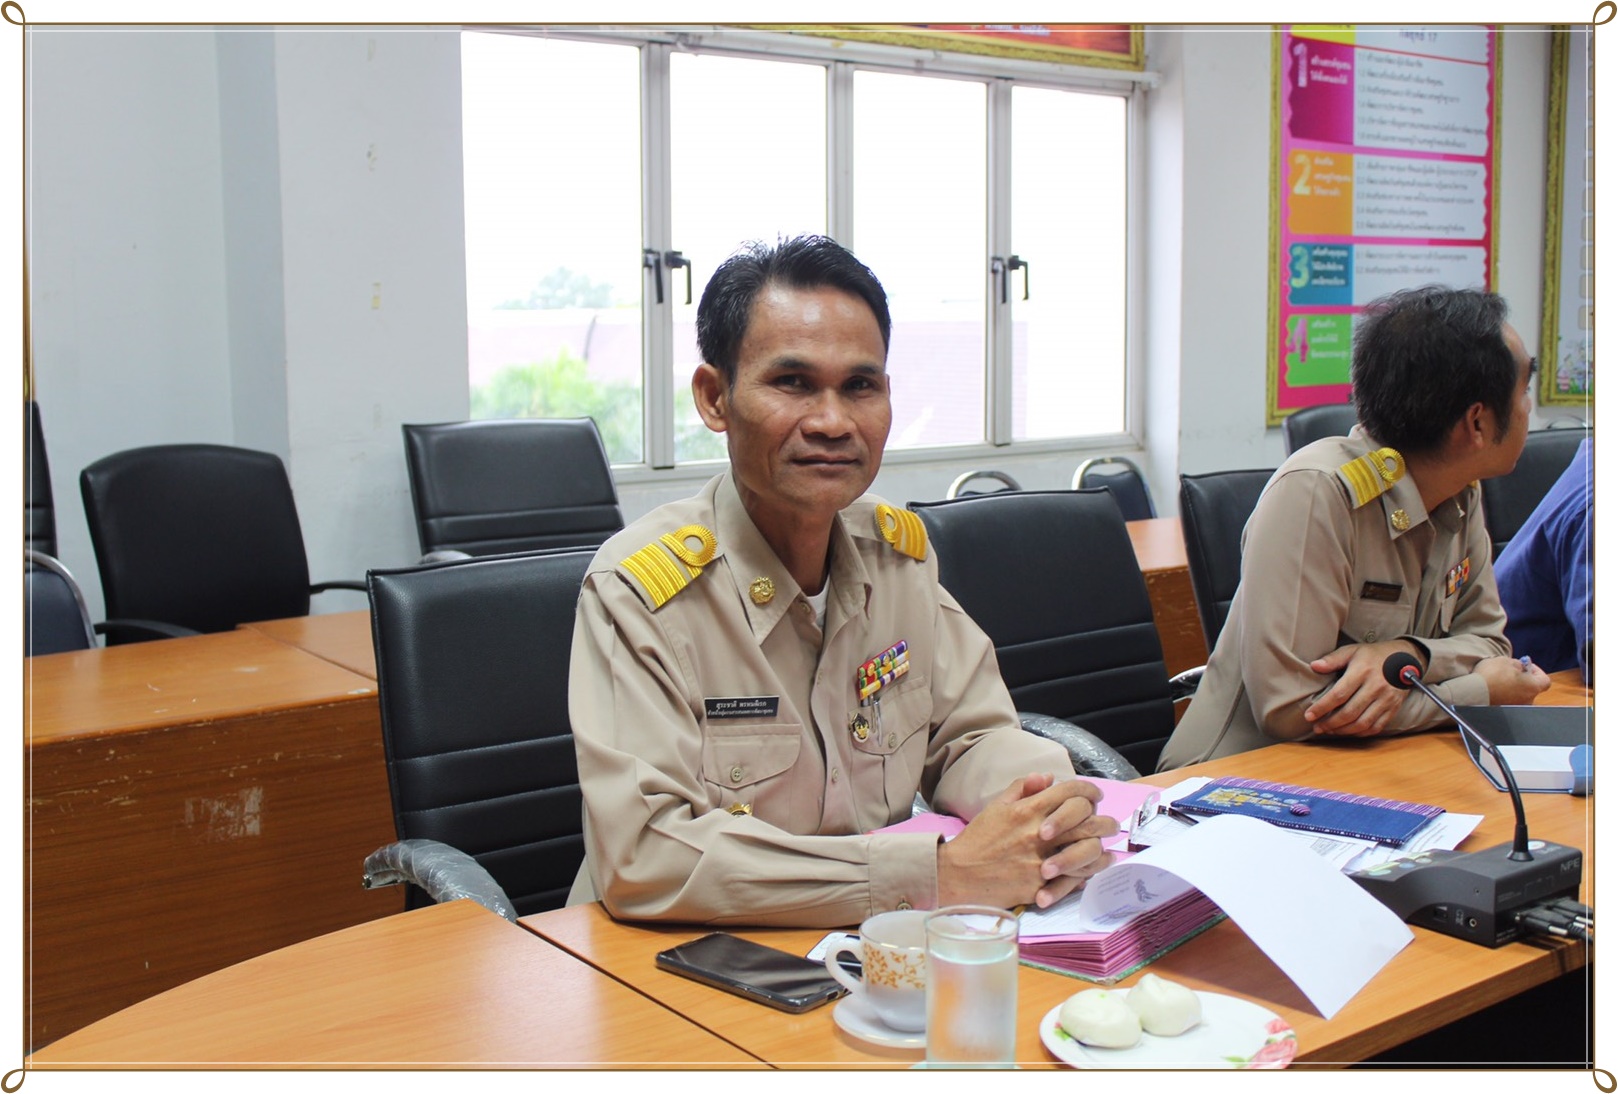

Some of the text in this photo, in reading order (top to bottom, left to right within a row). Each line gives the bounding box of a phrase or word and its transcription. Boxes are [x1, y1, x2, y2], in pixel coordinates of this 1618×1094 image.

[1293, 43, 1307, 87] 1
[1294, 154, 1311, 196] 2
[1291, 246, 1309, 288] 3
[1288, 317, 1309, 364] 4
[1560, 857, 1580, 873] NPE
